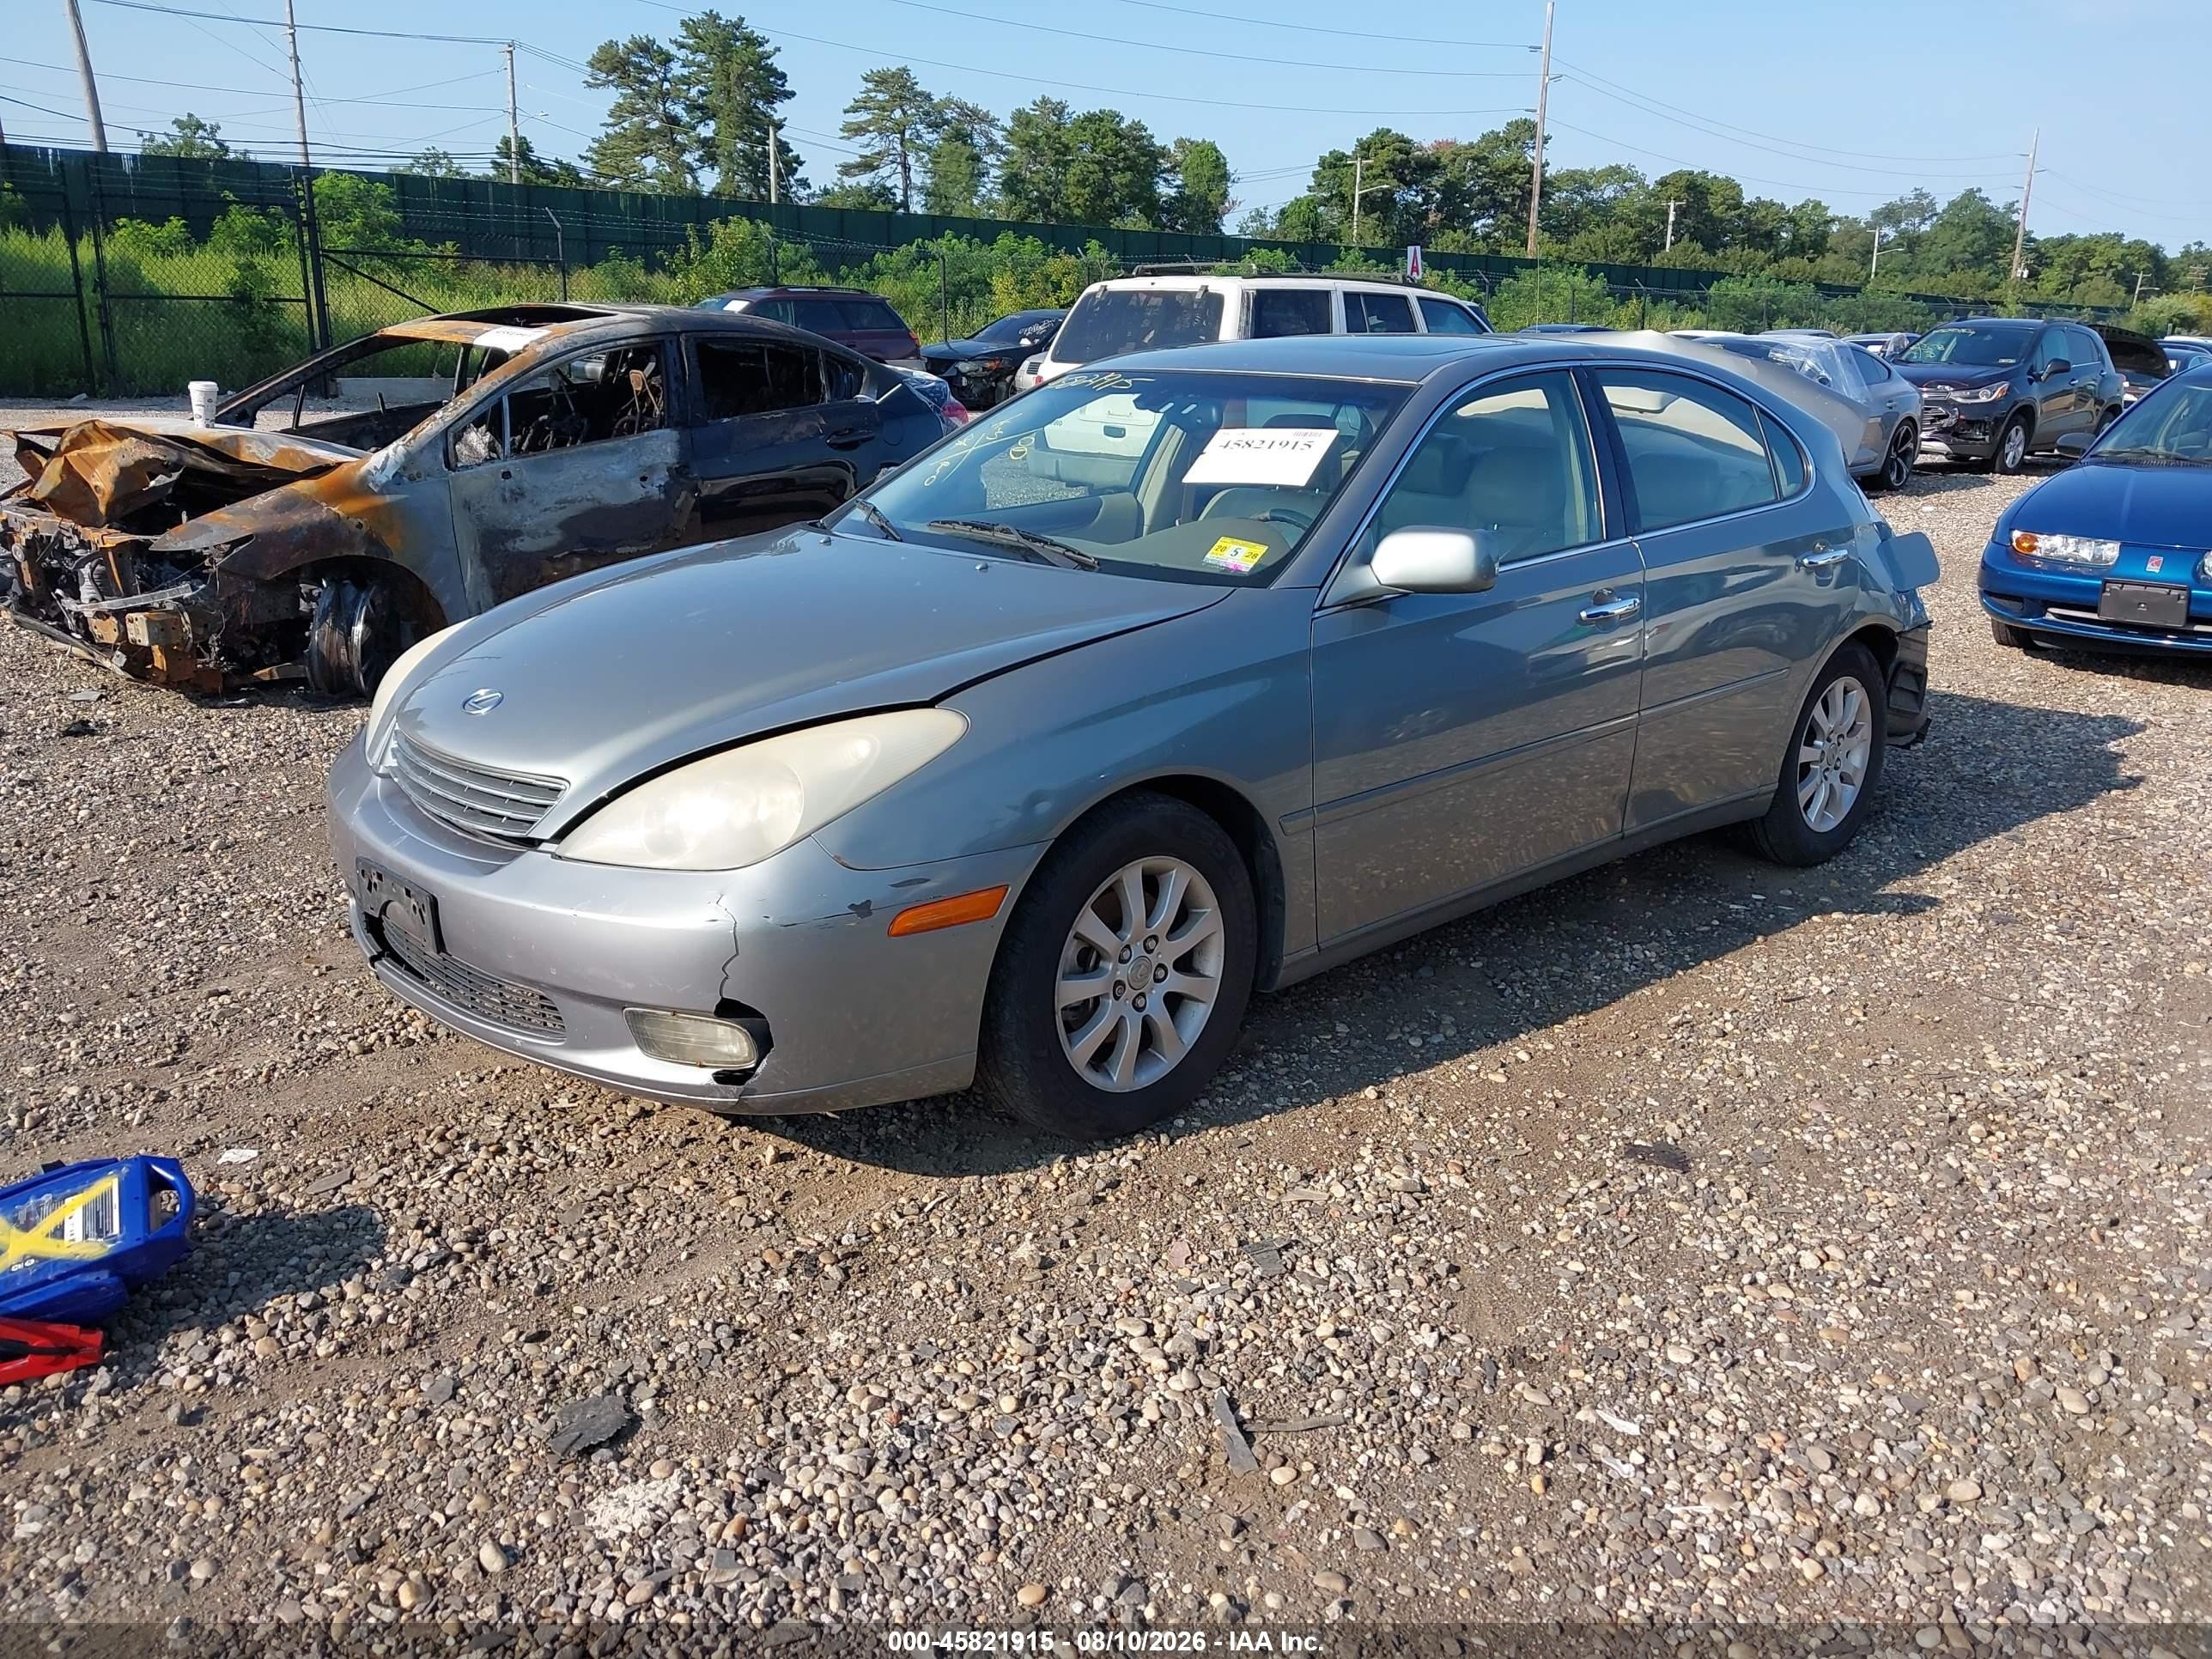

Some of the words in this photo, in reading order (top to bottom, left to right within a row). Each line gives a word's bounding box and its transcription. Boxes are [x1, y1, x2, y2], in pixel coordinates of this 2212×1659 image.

[1410, 246, 1419, 276] A
[1218, 439, 1315, 451] 45821915
[1231, 547, 1242, 556] 5
